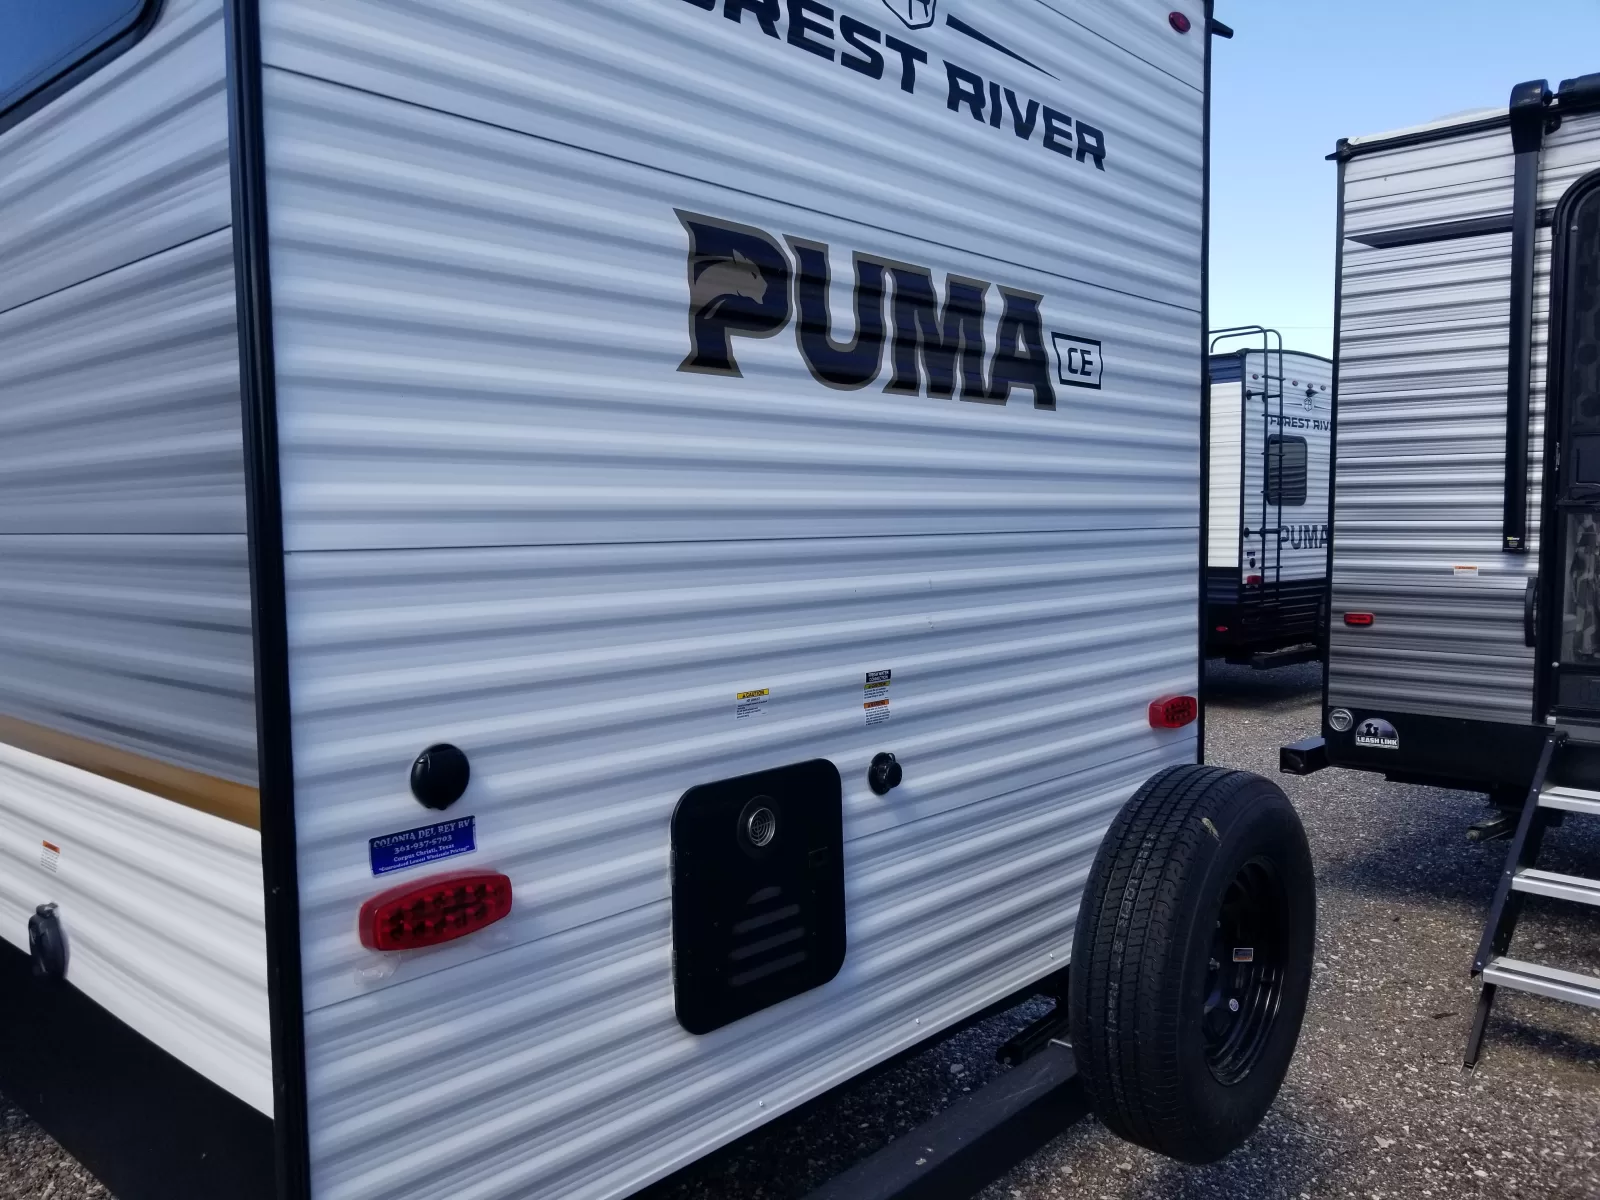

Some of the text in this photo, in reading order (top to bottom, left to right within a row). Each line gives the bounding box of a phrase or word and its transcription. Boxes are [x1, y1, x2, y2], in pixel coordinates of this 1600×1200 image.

[682, 0, 1106, 172] REST RIVER
[673, 208, 1094, 412] PUMA CE
[1313, 419, 1331, 431] RIV
[1280, 524, 1328, 550] PUMA
[373, 819, 470, 849] COLONIA DEL REY RV
[393, 834, 453, 855] 361-937-5703
[393, 853, 415, 862] Corpus
[439, 843, 455, 851] Texas
